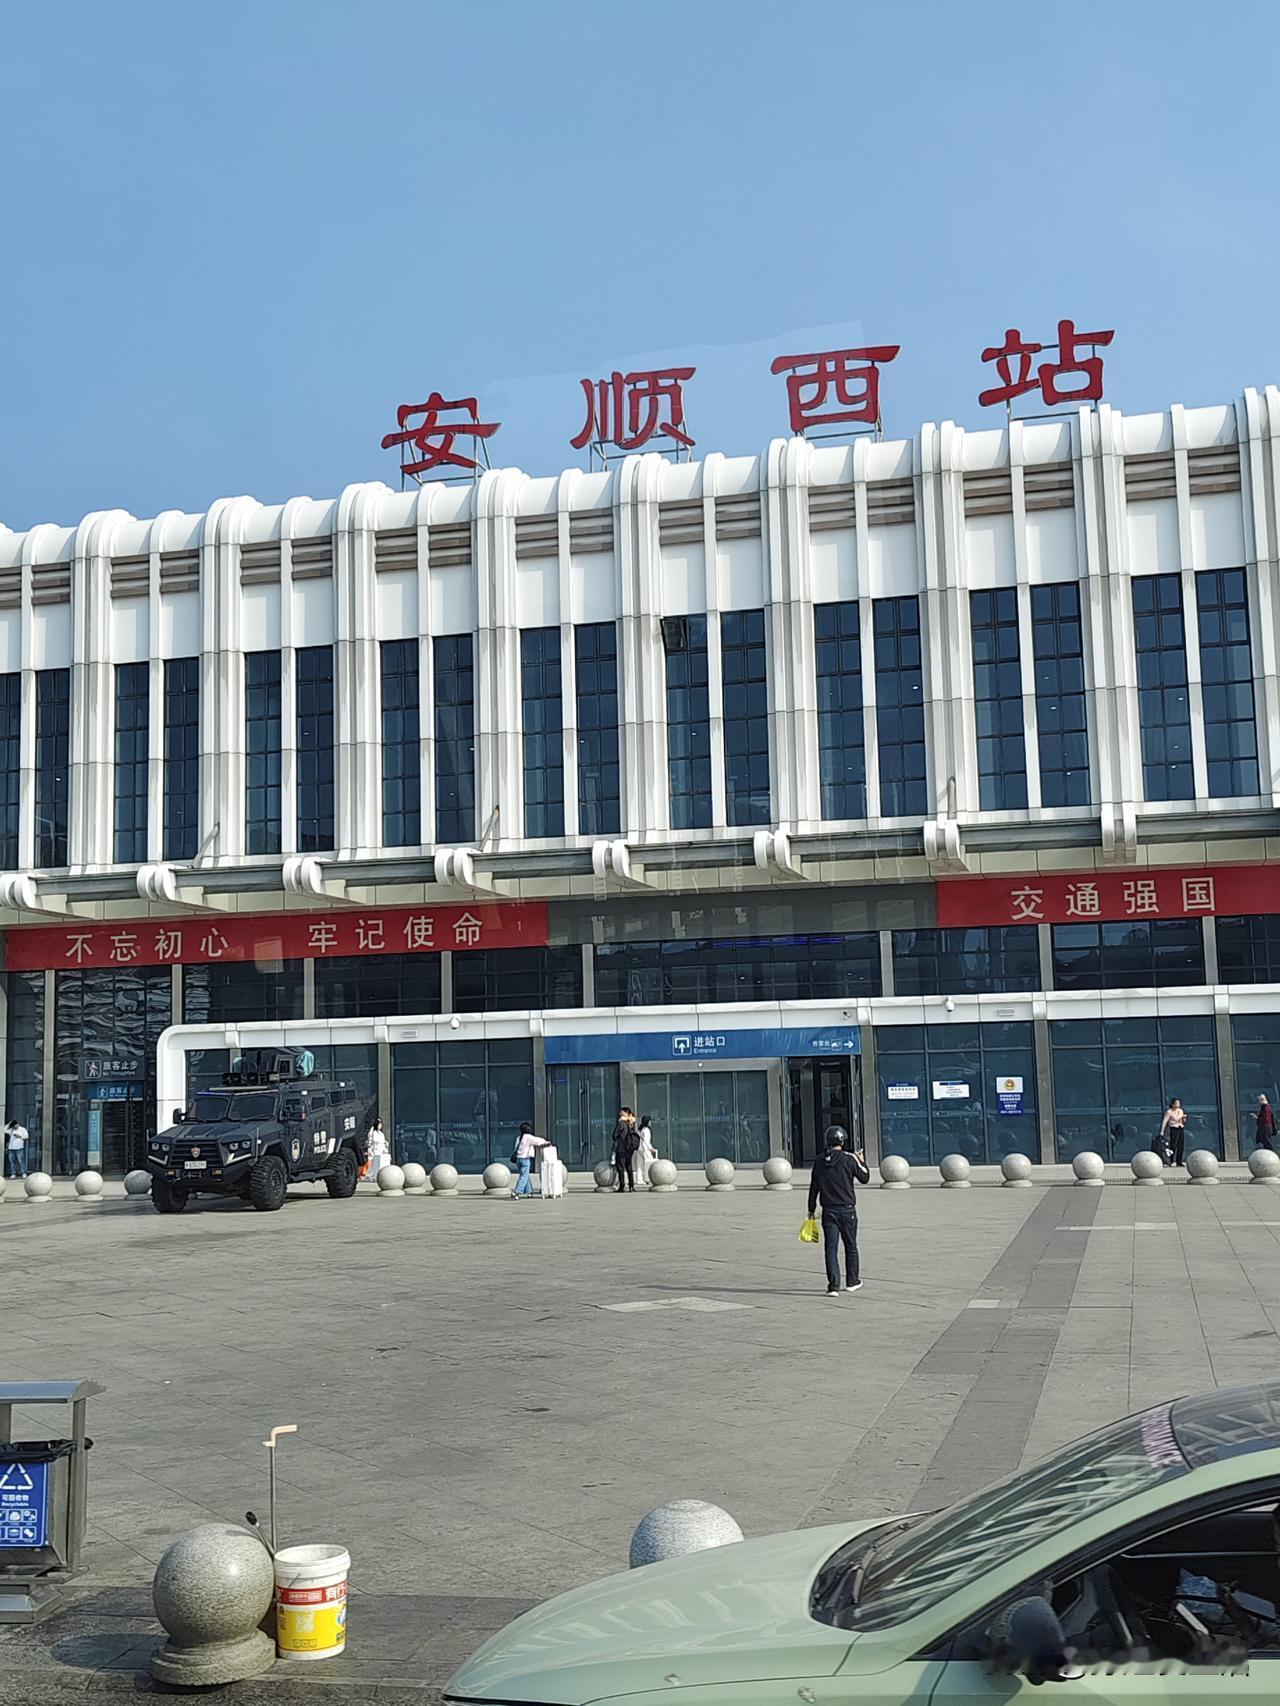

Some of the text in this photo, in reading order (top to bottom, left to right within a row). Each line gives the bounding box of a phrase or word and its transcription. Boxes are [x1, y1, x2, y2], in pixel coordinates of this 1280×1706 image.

[381, 320, 1115, 474] 安顺西站
[1010, 876, 1217, 921] 交通强国
[65, 911, 484, 964] 不忘初心 牢记使命
[694, 1036, 725, 1047] 进站口
[103, 1060, 138, 1070] 旅客止步
[314, 1131, 327, 1145] 特警
[314, 1144, 327, 1154] POLICE
